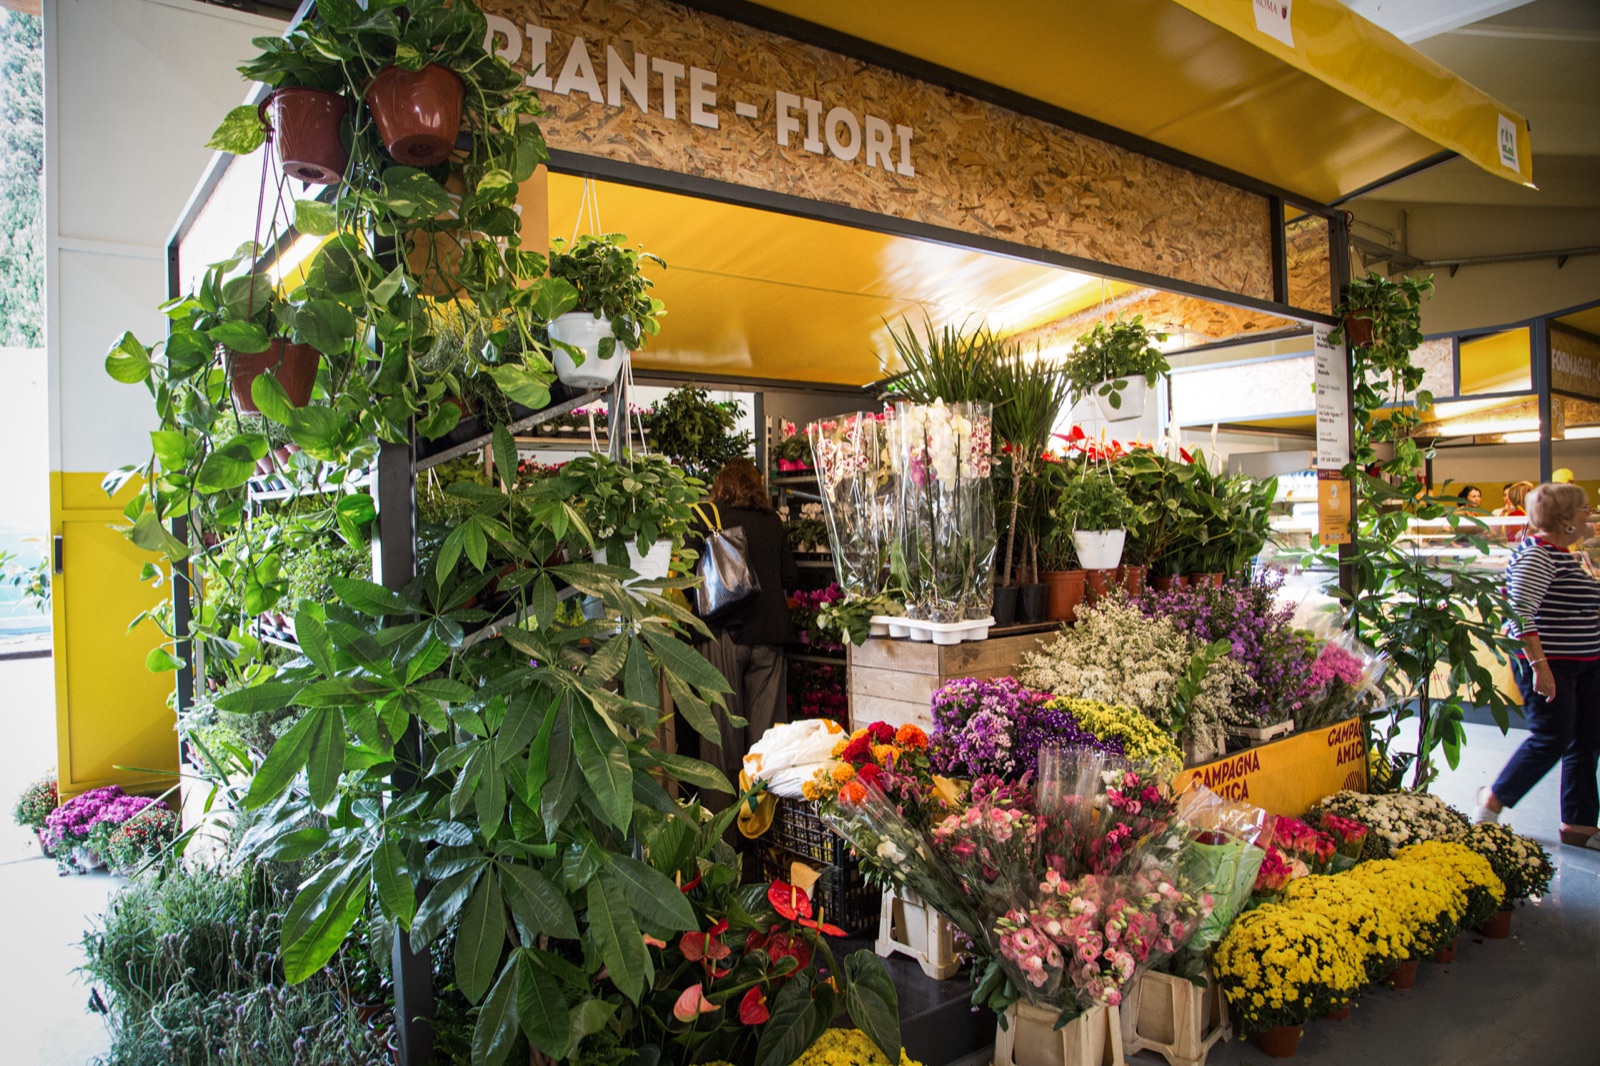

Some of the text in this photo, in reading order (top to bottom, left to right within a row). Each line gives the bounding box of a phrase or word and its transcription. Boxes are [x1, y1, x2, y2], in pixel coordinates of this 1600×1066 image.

[483, 13, 915, 178] PIANTE - FIORI
[1192, 750, 1260, 792] CAMPAGNA
[1214, 779, 1249, 803] ICA
